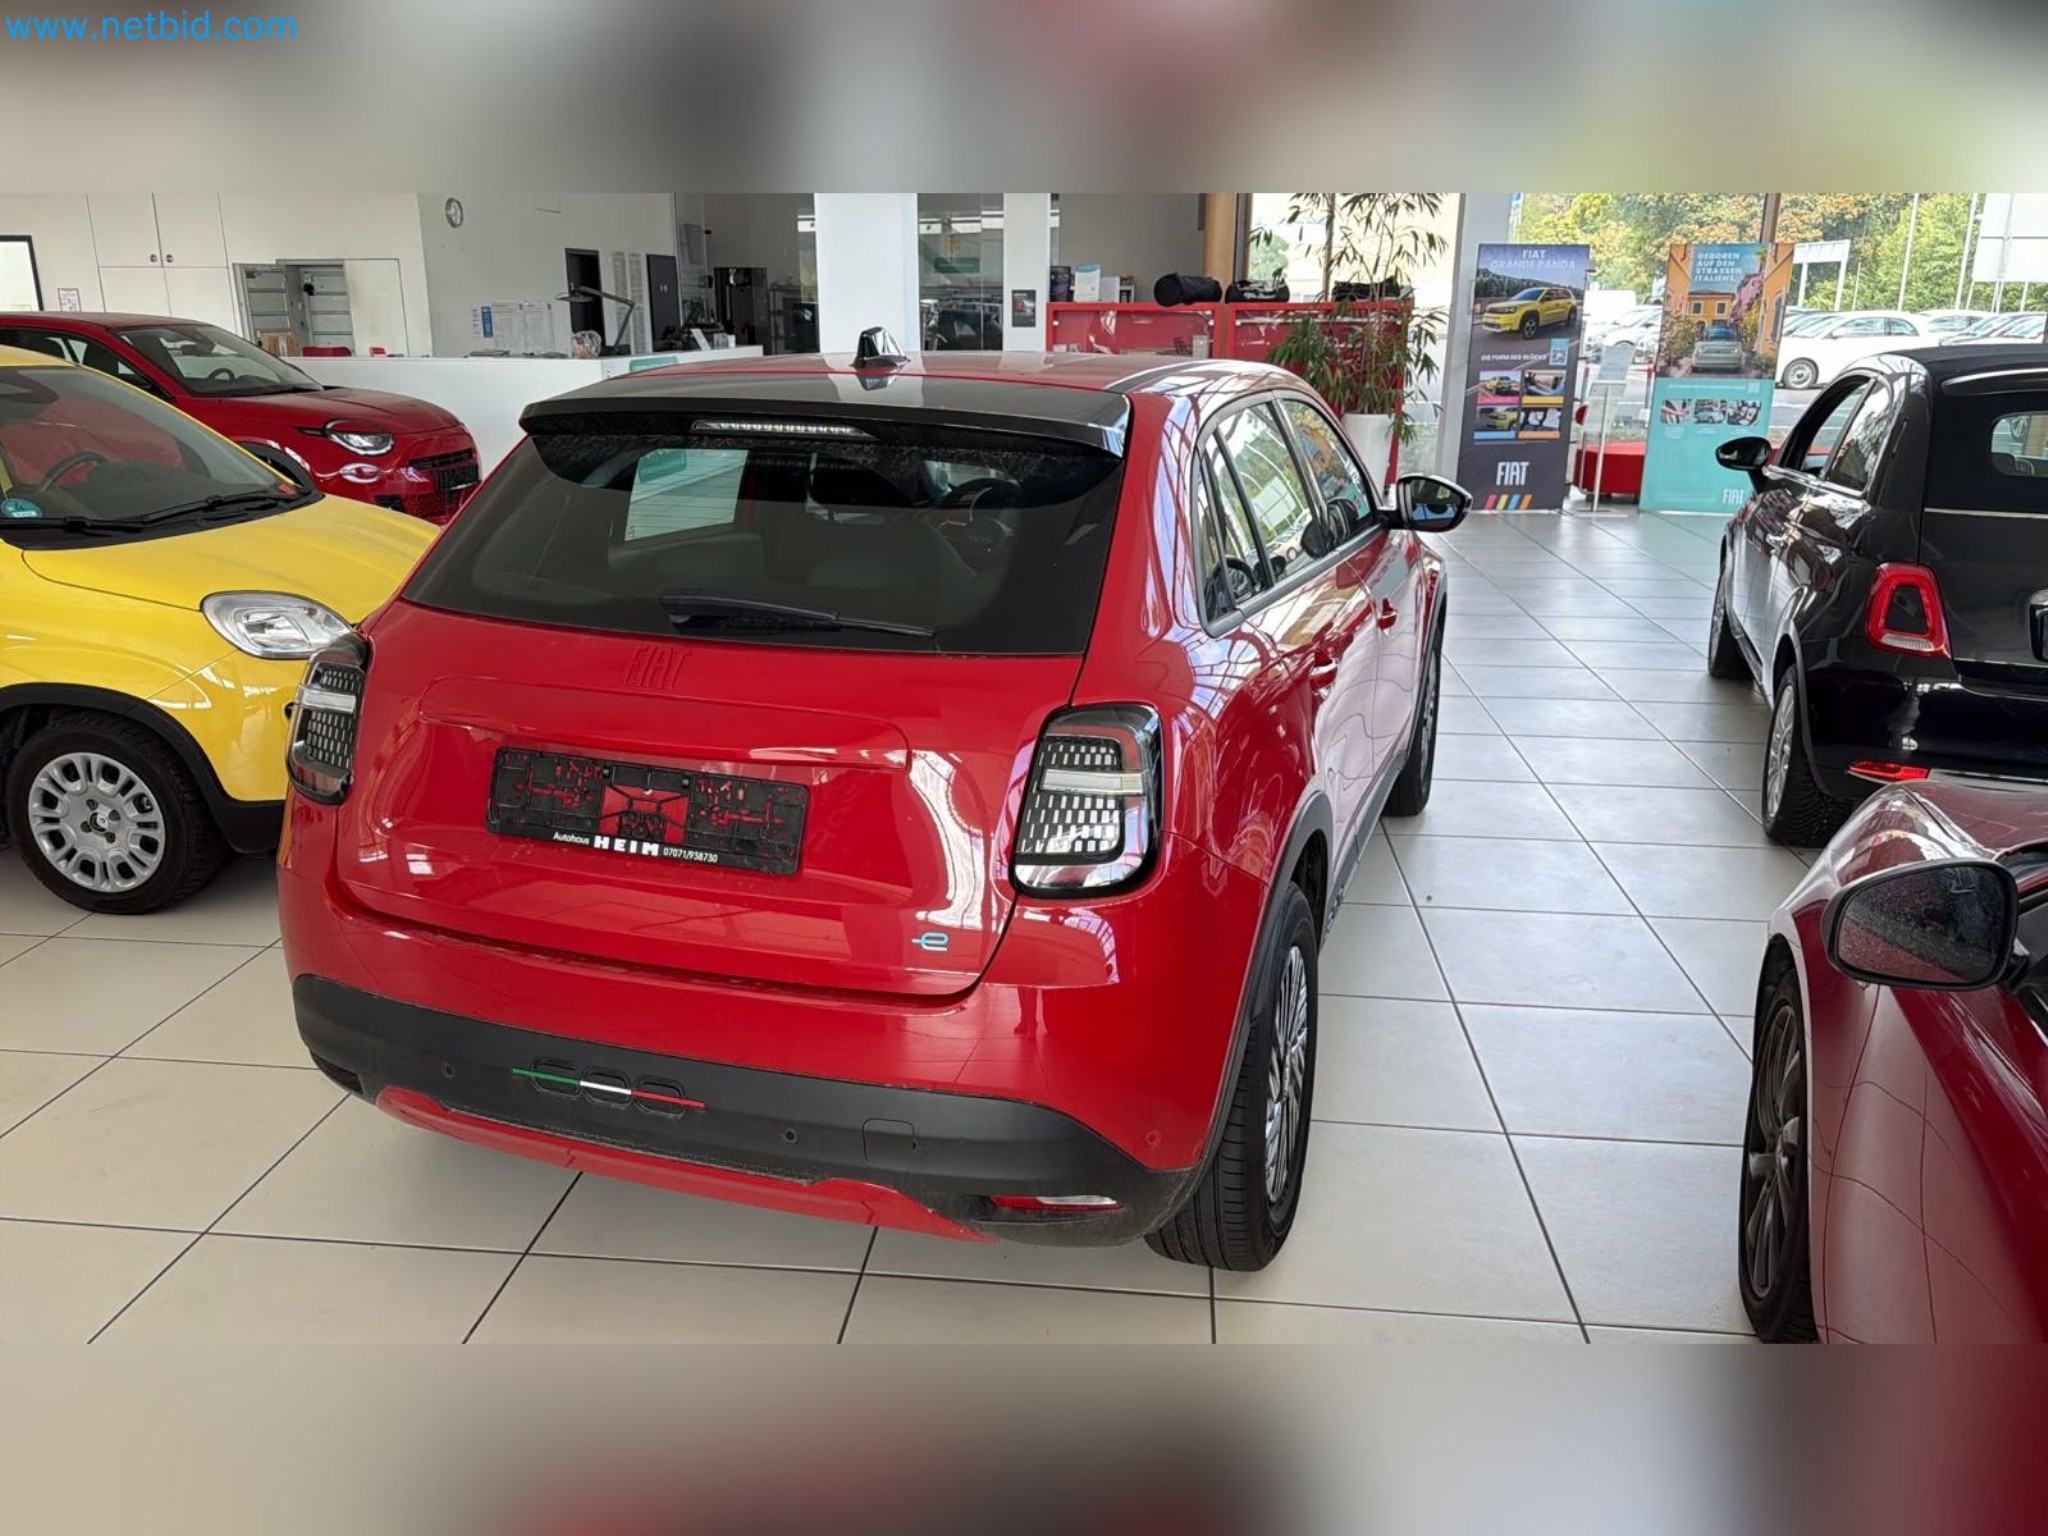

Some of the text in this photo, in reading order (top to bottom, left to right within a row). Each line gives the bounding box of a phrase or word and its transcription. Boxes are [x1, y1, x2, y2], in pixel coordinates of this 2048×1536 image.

[1522, 249, 1547, 259] FIAT
[1697, 252, 1740, 260] GEBOREN
[1695, 267, 1742, 275] STRASSEN
[1495, 461, 1530, 486] FIAT
[1723, 488, 1745, 505] FIAT
[553, 831, 590, 845] Autohaus
[594, 835, 660, 857] HEIM
